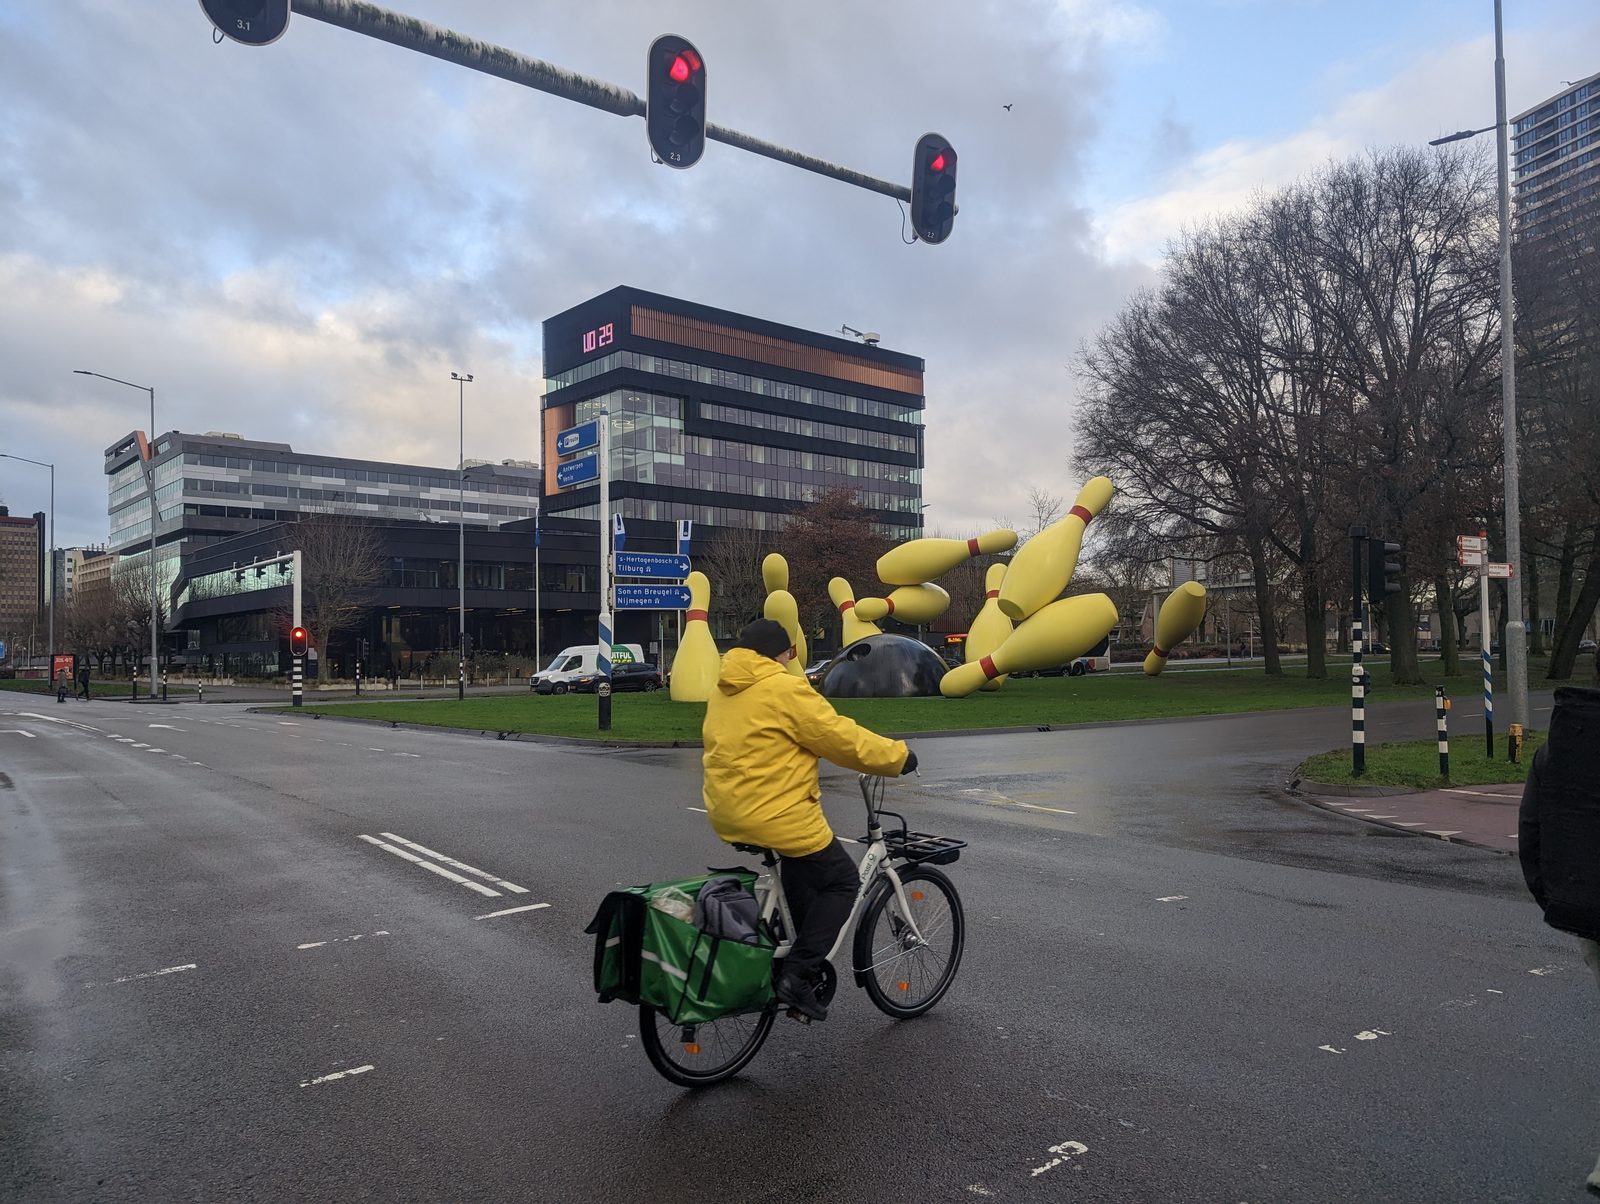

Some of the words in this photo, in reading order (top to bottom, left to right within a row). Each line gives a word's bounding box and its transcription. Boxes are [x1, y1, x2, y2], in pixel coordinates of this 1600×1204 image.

[236, 19, 250, 31] 3.1
[599, 322, 614, 347] 29
[617, 565, 644, 574] Tilburg
[644, 588, 672, 596] Breugel
[617, 597, 653, 606] Nijmegen
